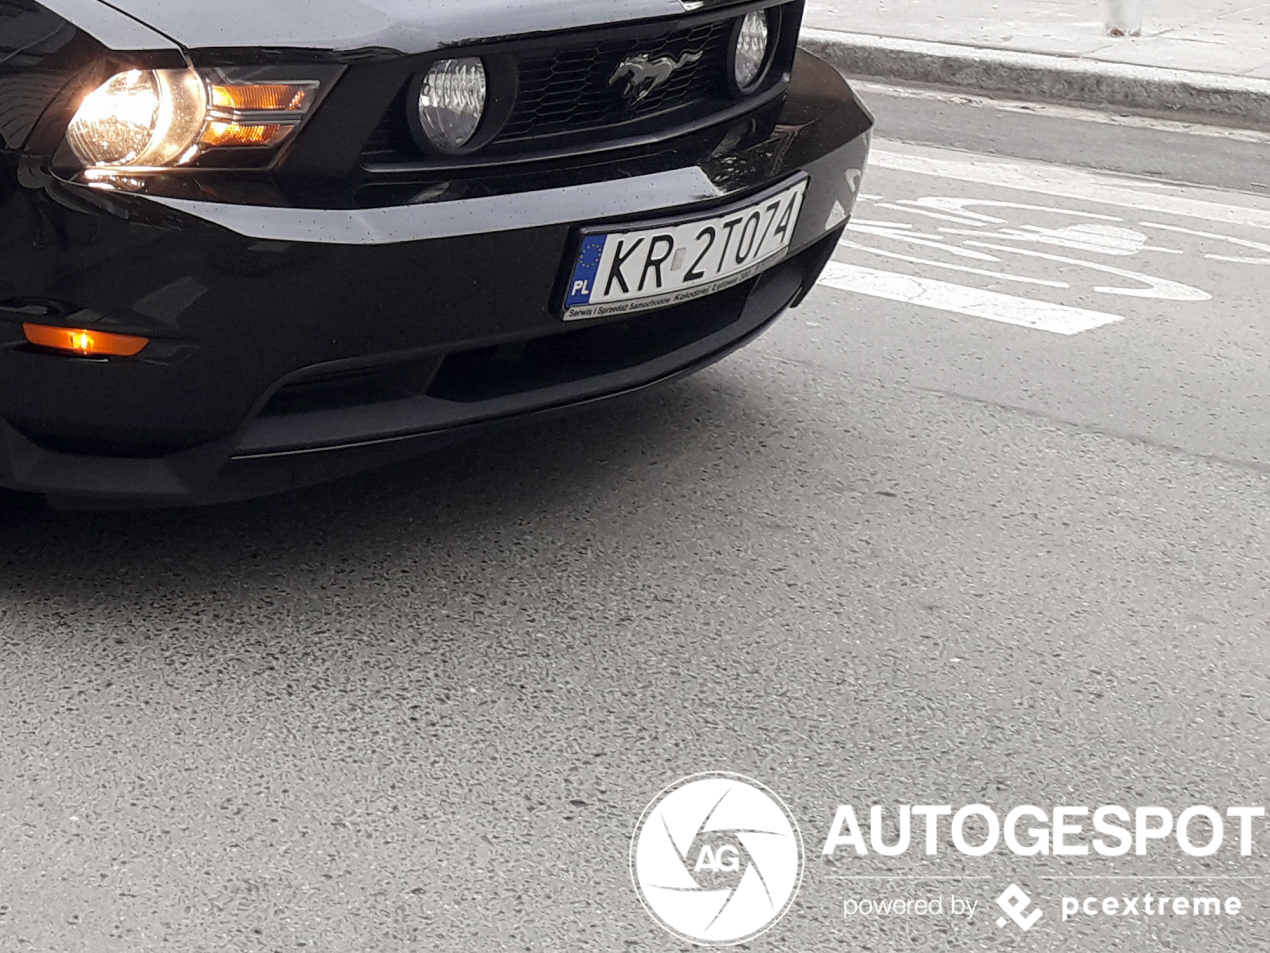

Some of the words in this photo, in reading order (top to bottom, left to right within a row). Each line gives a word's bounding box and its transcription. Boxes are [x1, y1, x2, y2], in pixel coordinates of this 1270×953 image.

[603, 234, 674, 296] KR
[682, 190, 797, 283] 2T074
[571, 279, 589, 296] PL
[568, 308, 593, 318] Serwis
